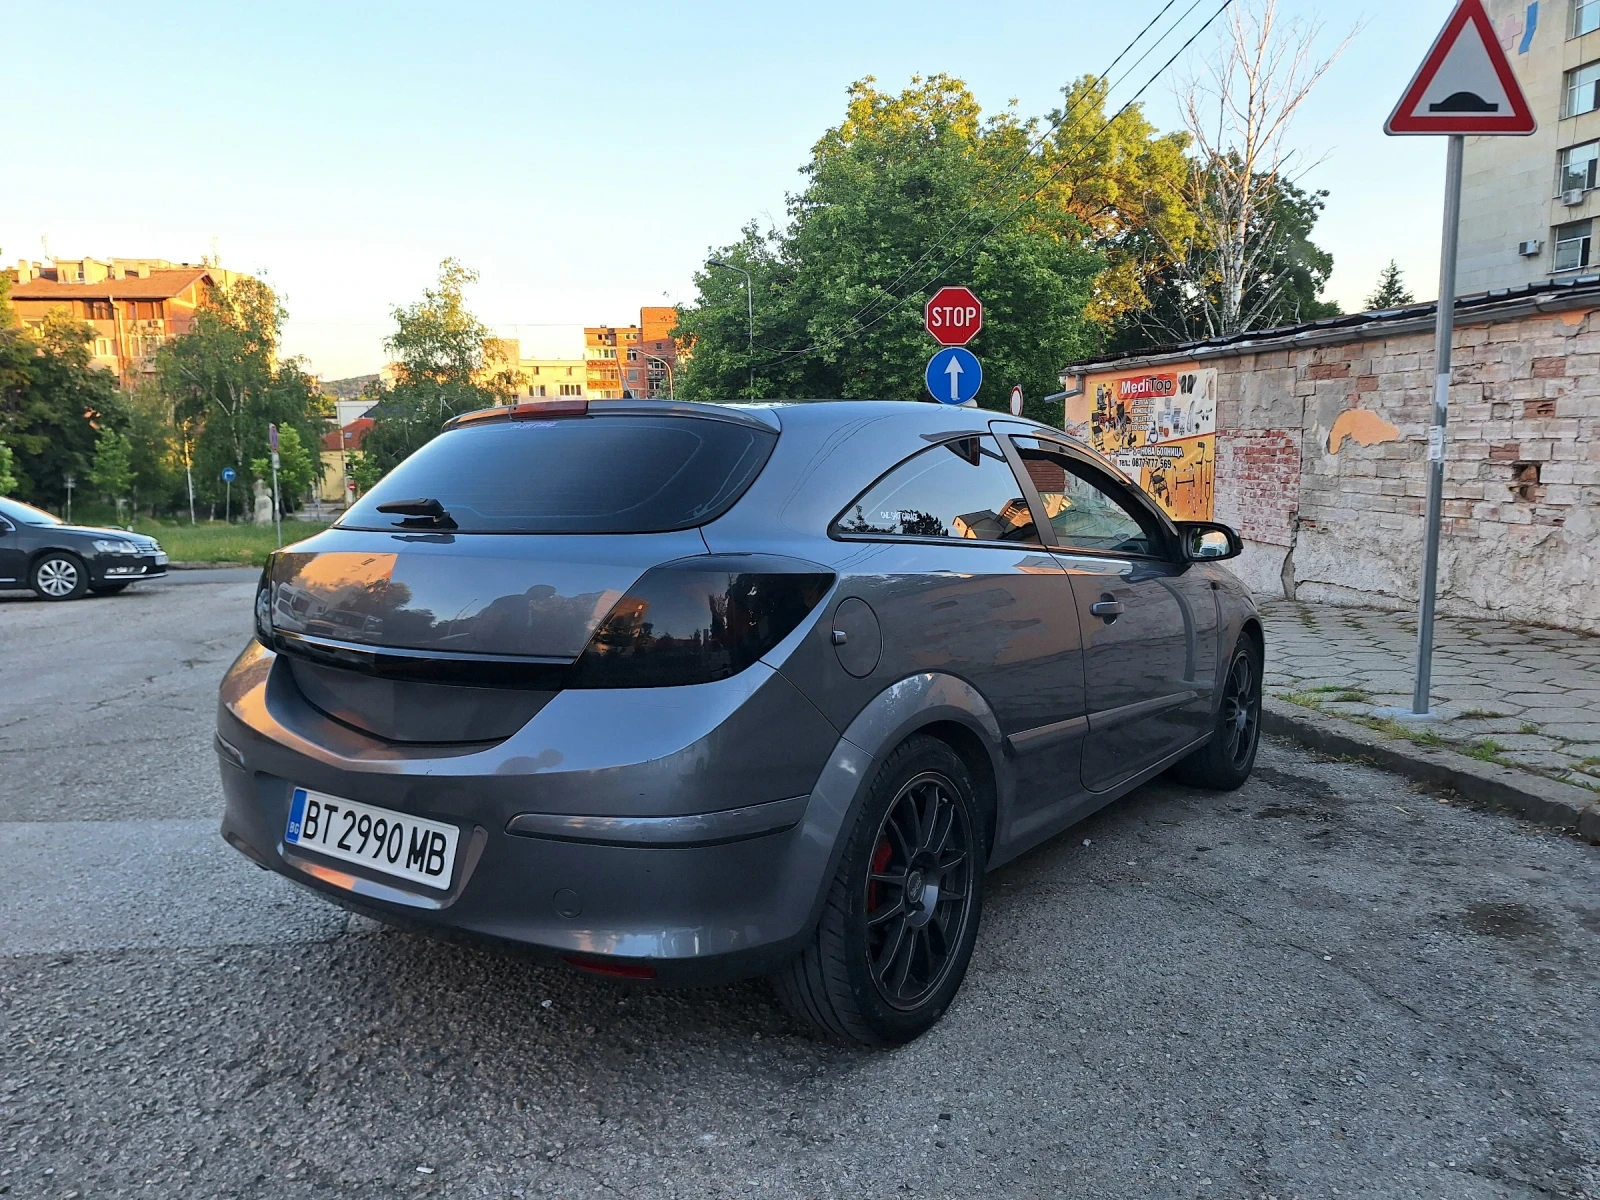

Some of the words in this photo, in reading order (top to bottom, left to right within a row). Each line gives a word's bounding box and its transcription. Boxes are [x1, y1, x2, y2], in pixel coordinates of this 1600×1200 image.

[932, 307, 976, 326] STOP
[1121, 378, 1172, 394] MediTop
[1146, 458, 1158, 468] 777
[1160, 459, 1172, 469] 569
[289, 821, 300, 835] BG
[302, 799, 339, 844] BT
[337, 810, 404, 864] 2990
[405, 826, 448, 877] MB
